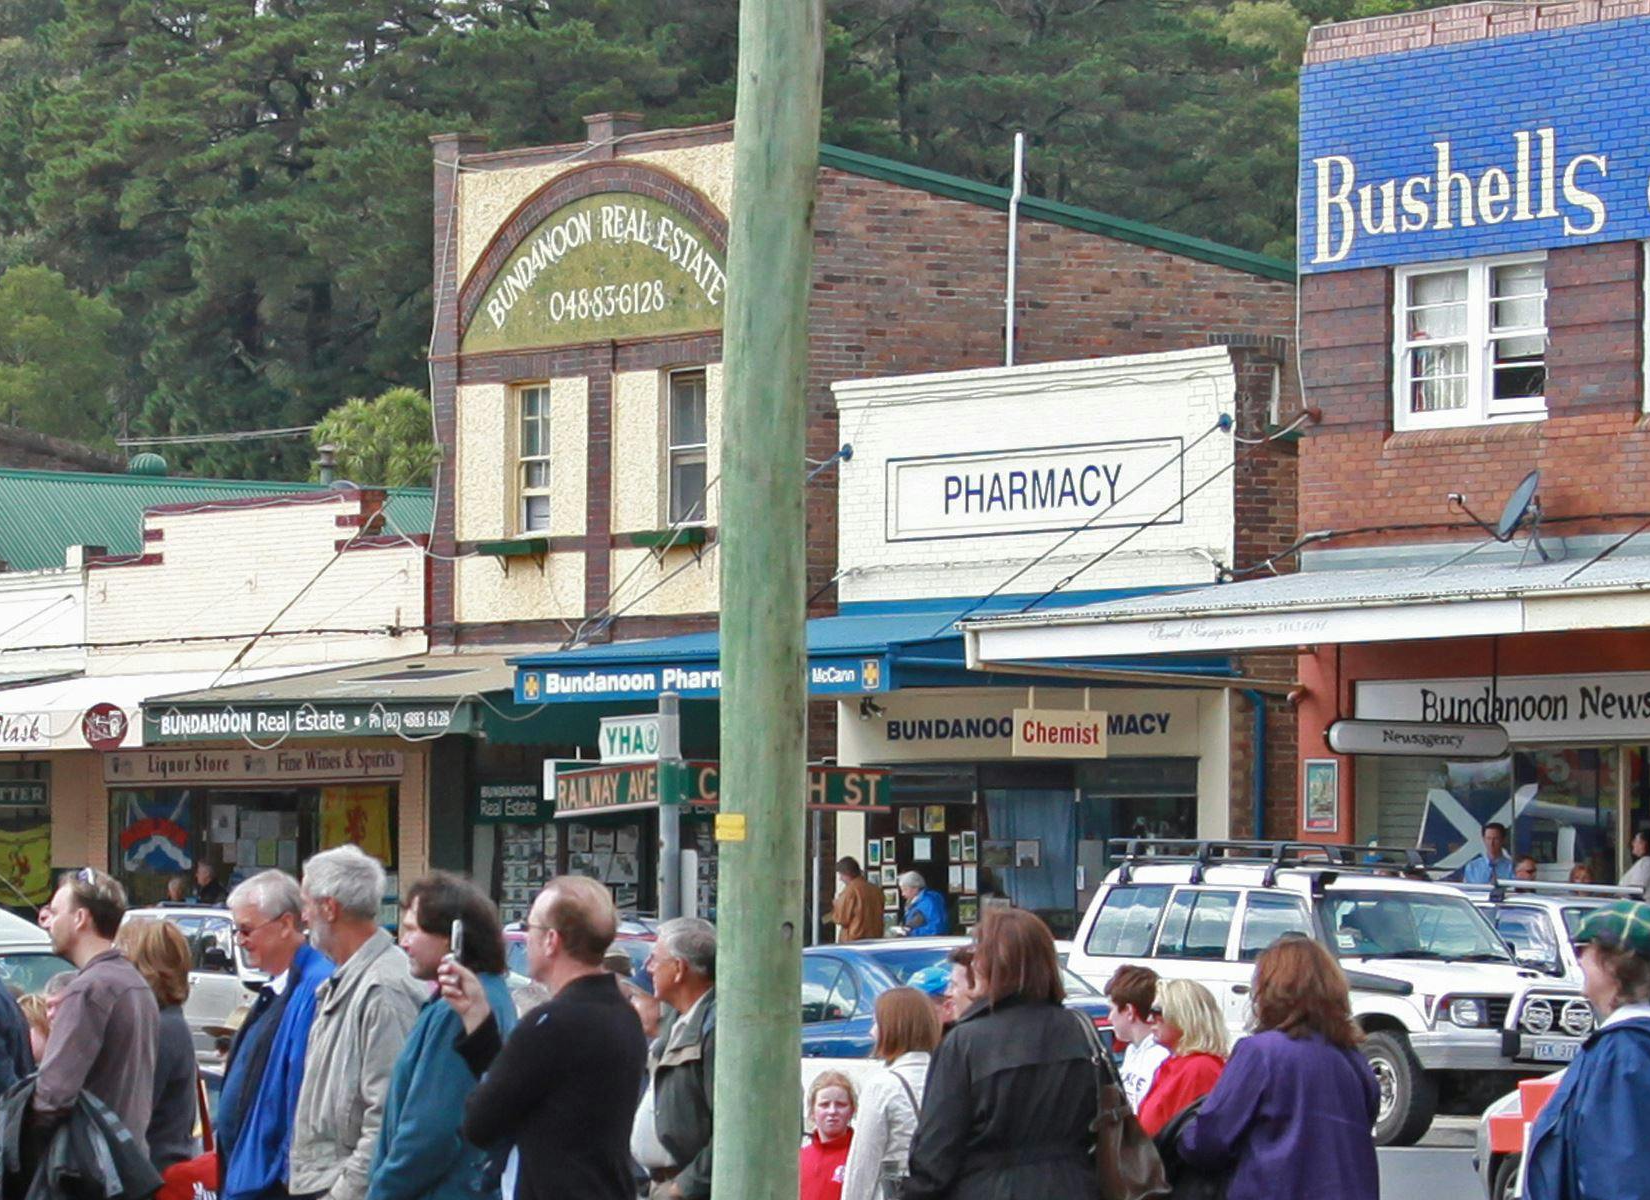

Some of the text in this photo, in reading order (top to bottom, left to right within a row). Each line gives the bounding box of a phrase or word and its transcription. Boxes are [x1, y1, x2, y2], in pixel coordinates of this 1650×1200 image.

[1310, 127, 1609, 265] Bushells
[485, 203, 728, 330] BUNDANOON REAL ESTATE
[944, 462, 1123, 515] PHARMACY
[545, 669, 656, 695] Bundanoon
[811, 667, 856, 684] McCann
[1421, 687, 1569, 726] Bundanoon
[160, 711, 252, 736] BUNDANOON
[256, 710, 291, 732] Real
[295, 709, 346, 731] Estate
[886, 712, 1172, 742] BUNDANOO MACY
[1022, 720, 1100, 745] Chemist
[605, 725, 644, 756] YHA
[1381, 729, 1466, 748] Newsagency
[147, 752, 231, 779] Liquor Store
[277, 750, 397, 775] Fine Wines & Spirits
[556, 772, 620, 811] RAILWAY
[627, 767, 657, 802] AVE
[843, 773, 883, 807] ST
[480, 800, 538, 817] Real Estate
